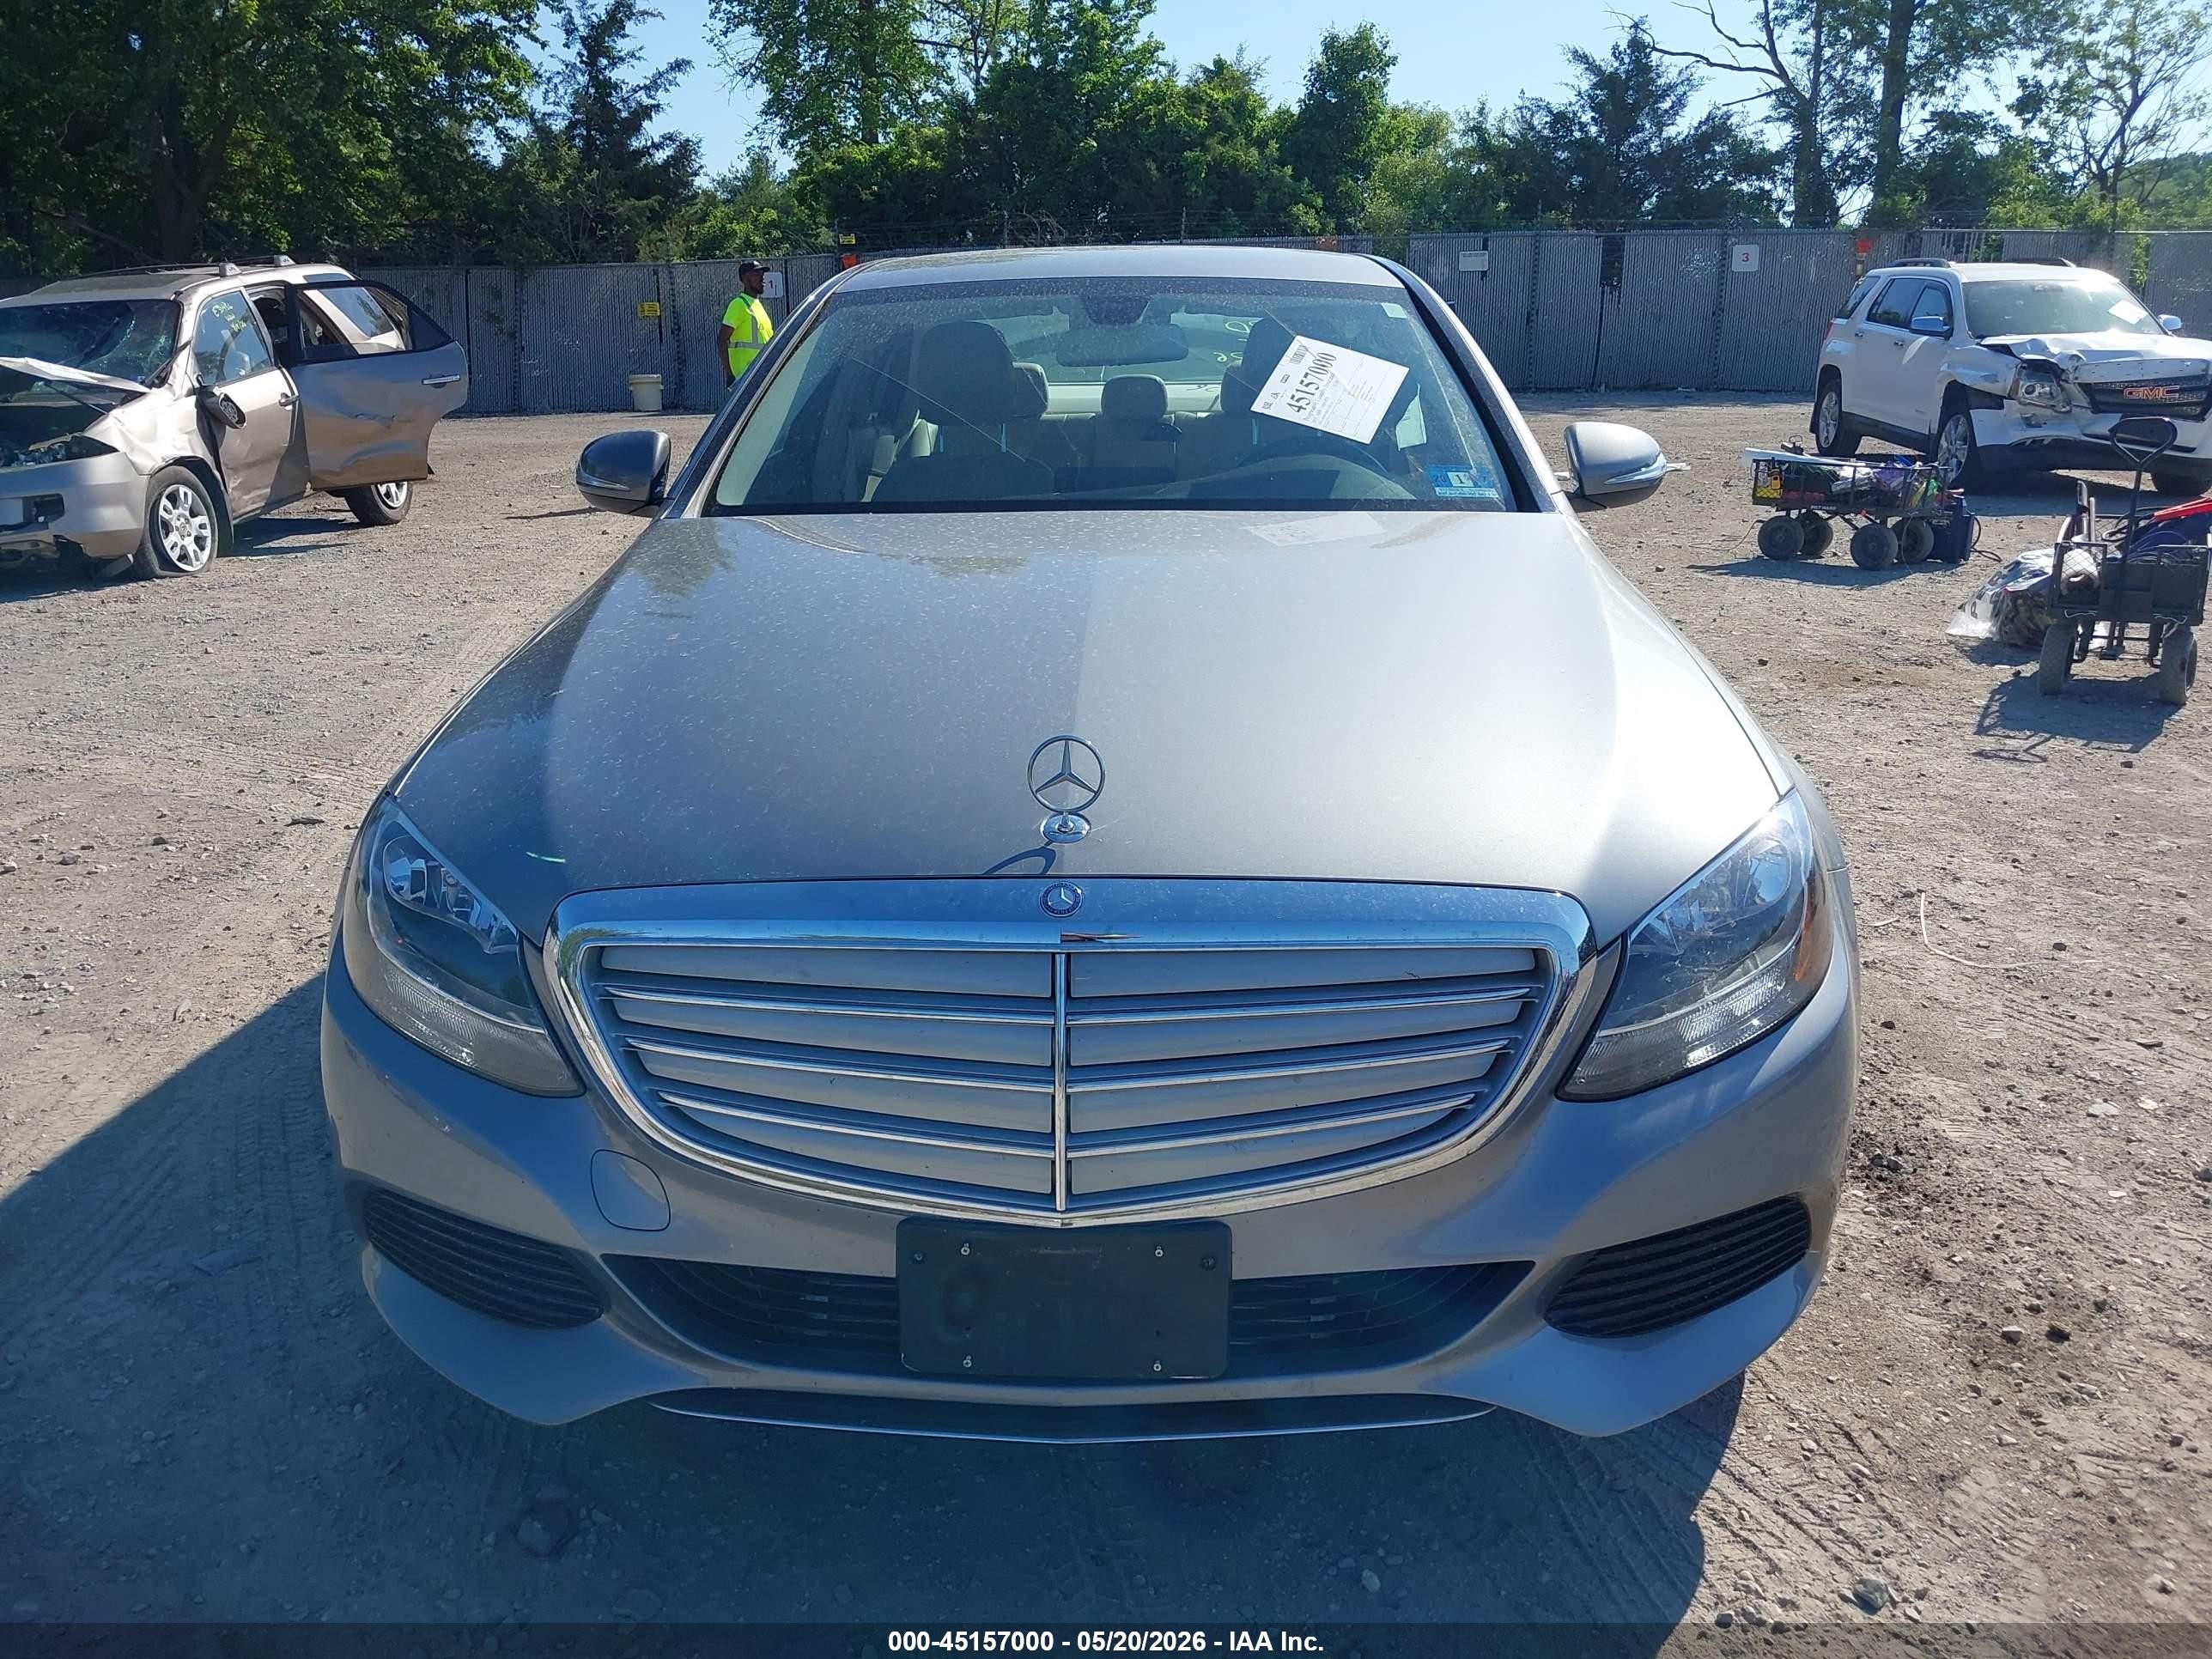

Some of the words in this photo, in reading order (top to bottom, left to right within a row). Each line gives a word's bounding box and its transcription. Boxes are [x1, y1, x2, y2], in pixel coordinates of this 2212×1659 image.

[1741, 252, 1750, 263] 3
[1286, 352, 1337, 413] 45157000
[2124, 386, 2180, 399] GMC
